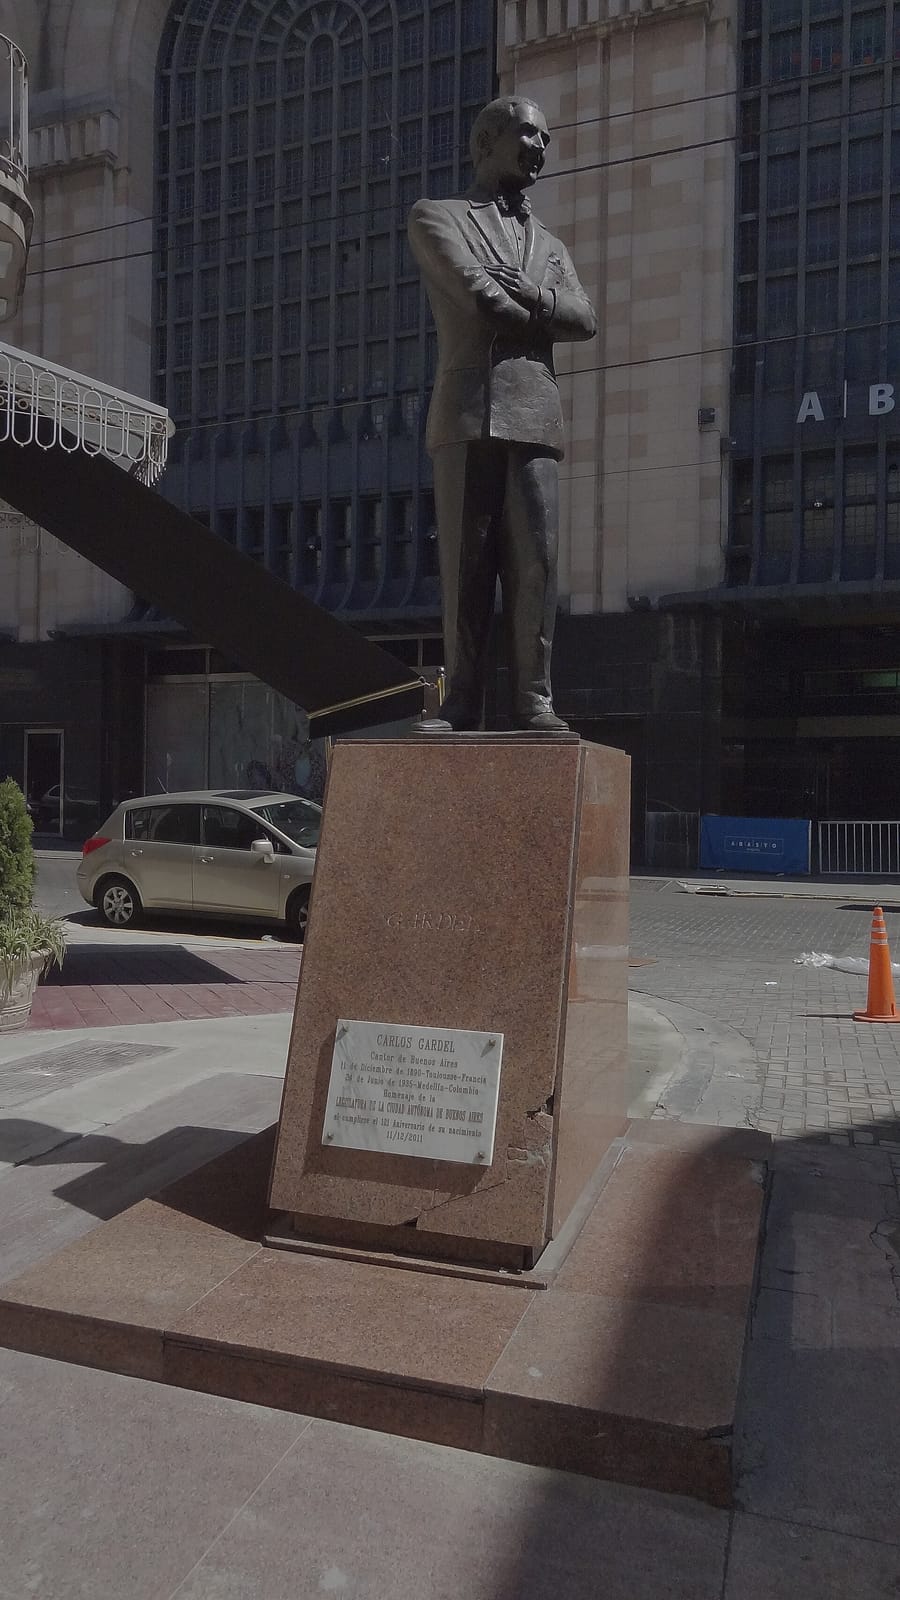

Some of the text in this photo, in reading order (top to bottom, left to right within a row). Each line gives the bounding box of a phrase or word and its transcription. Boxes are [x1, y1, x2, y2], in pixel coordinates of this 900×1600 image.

[376, 1034, 455, 1053] CARLOS GARDEL
[370, 1051, 458, 1068] Cantor de Buenos Aires
[340, 1061, 346, 1070] 11
[350, 1062, 358, 1070] de
[360, 1063, 392, 1074] Diciembre
[396, 1067, 404, 1076] de
[356, 1075, 364, 1083] de
[368, 1076, 384, 1085] Junio
[387, 1078, 394, 1087] de
[384, 1089, 414, 1102] Homenaje
[418, 1093, 426, 1102] de
[370, 1100, 376, 1111] DE
[378, 1100, 384, 1112] LA
[386, 1102, 404, 1114] CIUDAD
[436, 1108, 443, 1119] DE
[446, 1108, 466, 1121] BUENOS
[468, 1112, 484, 1123] AIRES
[386, 1130, 424, 1143] 11/12/2011
[392, 1120, 424, 1131] Aniversario
[428, 1123, 435, 1132] de
[448, 1127, 482, 1138] nacimiento
